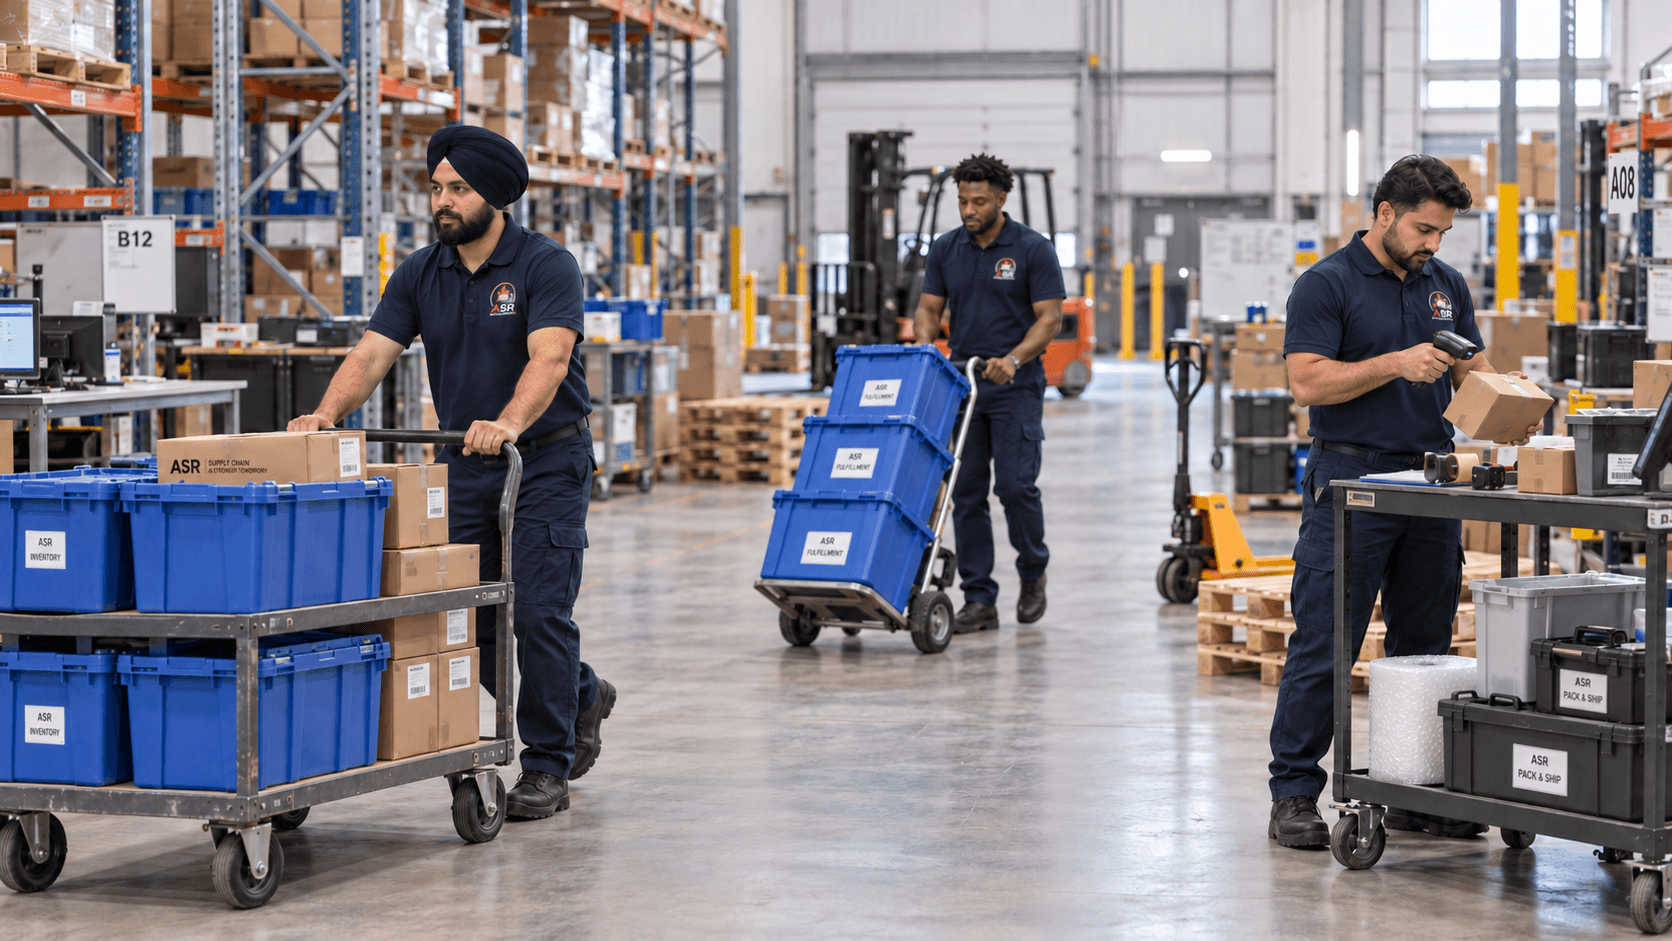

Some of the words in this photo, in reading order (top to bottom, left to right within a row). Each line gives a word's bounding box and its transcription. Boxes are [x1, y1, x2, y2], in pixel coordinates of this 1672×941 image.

[1610, 165, 1635, 200] A08
[118, 230, 153, 248] B12
[490, 303, 515, 314] ASR
[848, 452, 863, 461] ASR
[170, 459, 201, 474] ASR
[836, 463, 871, 471] FULFILLMENT
[38, 537, 53, 547] ASR
[820, 536, 835, 545] ASR
[30, 553, 61, 561] INVENTORY
[806, 548, 844, 557] FULFILLMENT
[1575, 677, 1592, 688] ASR
[1563, 690, 1580, 701] PACK
[1587, 694, 1604, 704] SHIP
[37, 712, 52, 722] ASR
[29, 727, 60, 736] INVENTORY
[1531, 754, 1549, 767] ASR
[1517, 768, 1537, 780] PACK
[1544, 773, 1562, 784] SHIP
